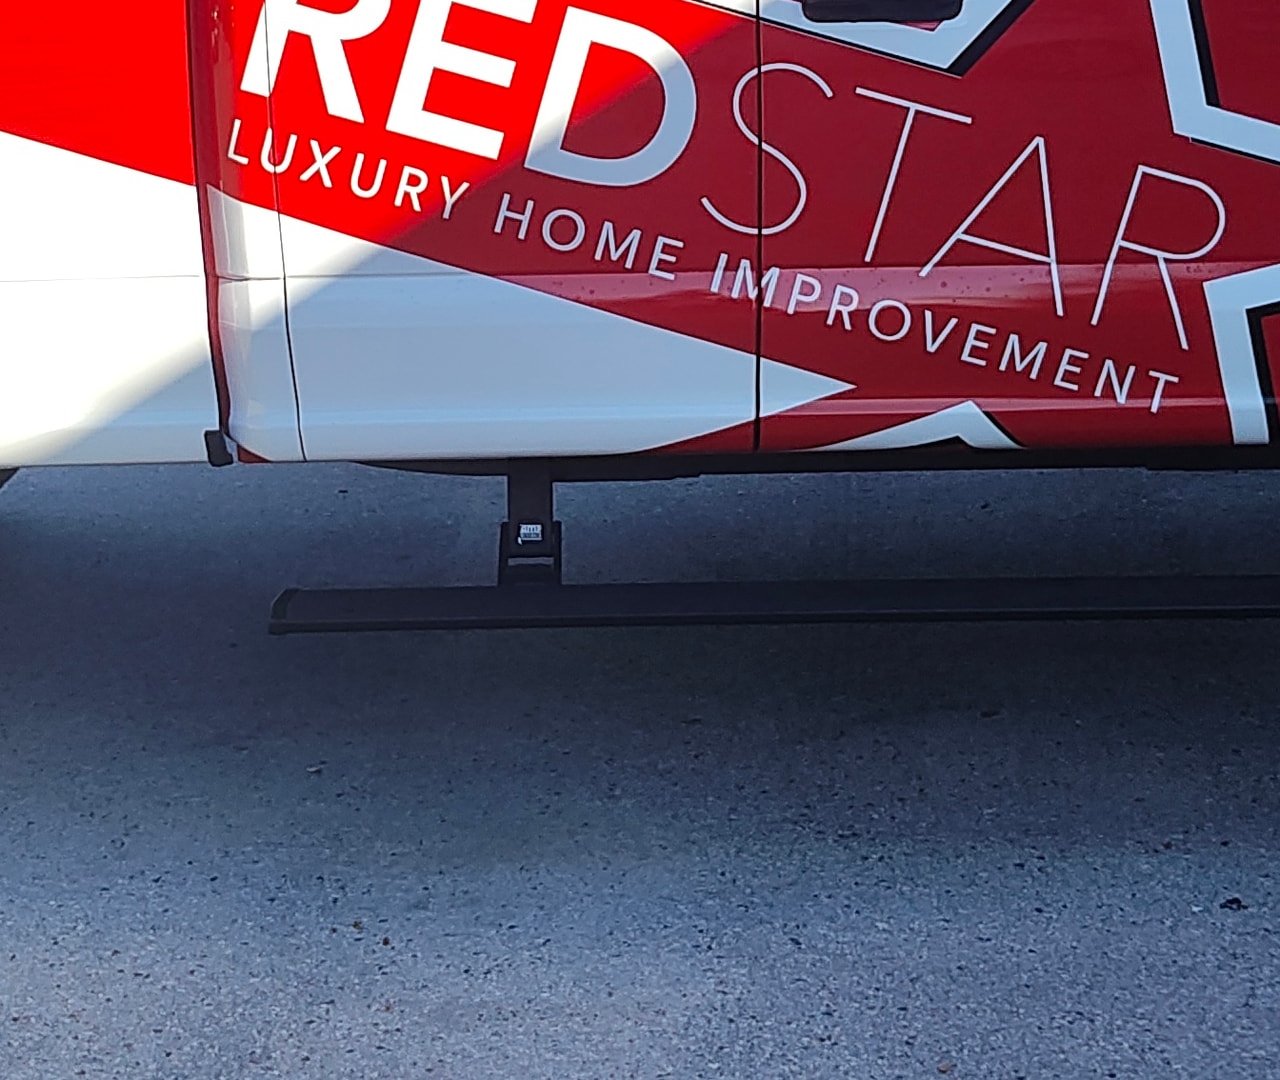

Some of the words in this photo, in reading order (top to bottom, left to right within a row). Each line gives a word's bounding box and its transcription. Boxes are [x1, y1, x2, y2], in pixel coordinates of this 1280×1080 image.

[227, 118, 470, 220] LUXURY
[494, 193, 685, 282] HOME
[709, 253, 1180, 415] IMPROVEMENT
